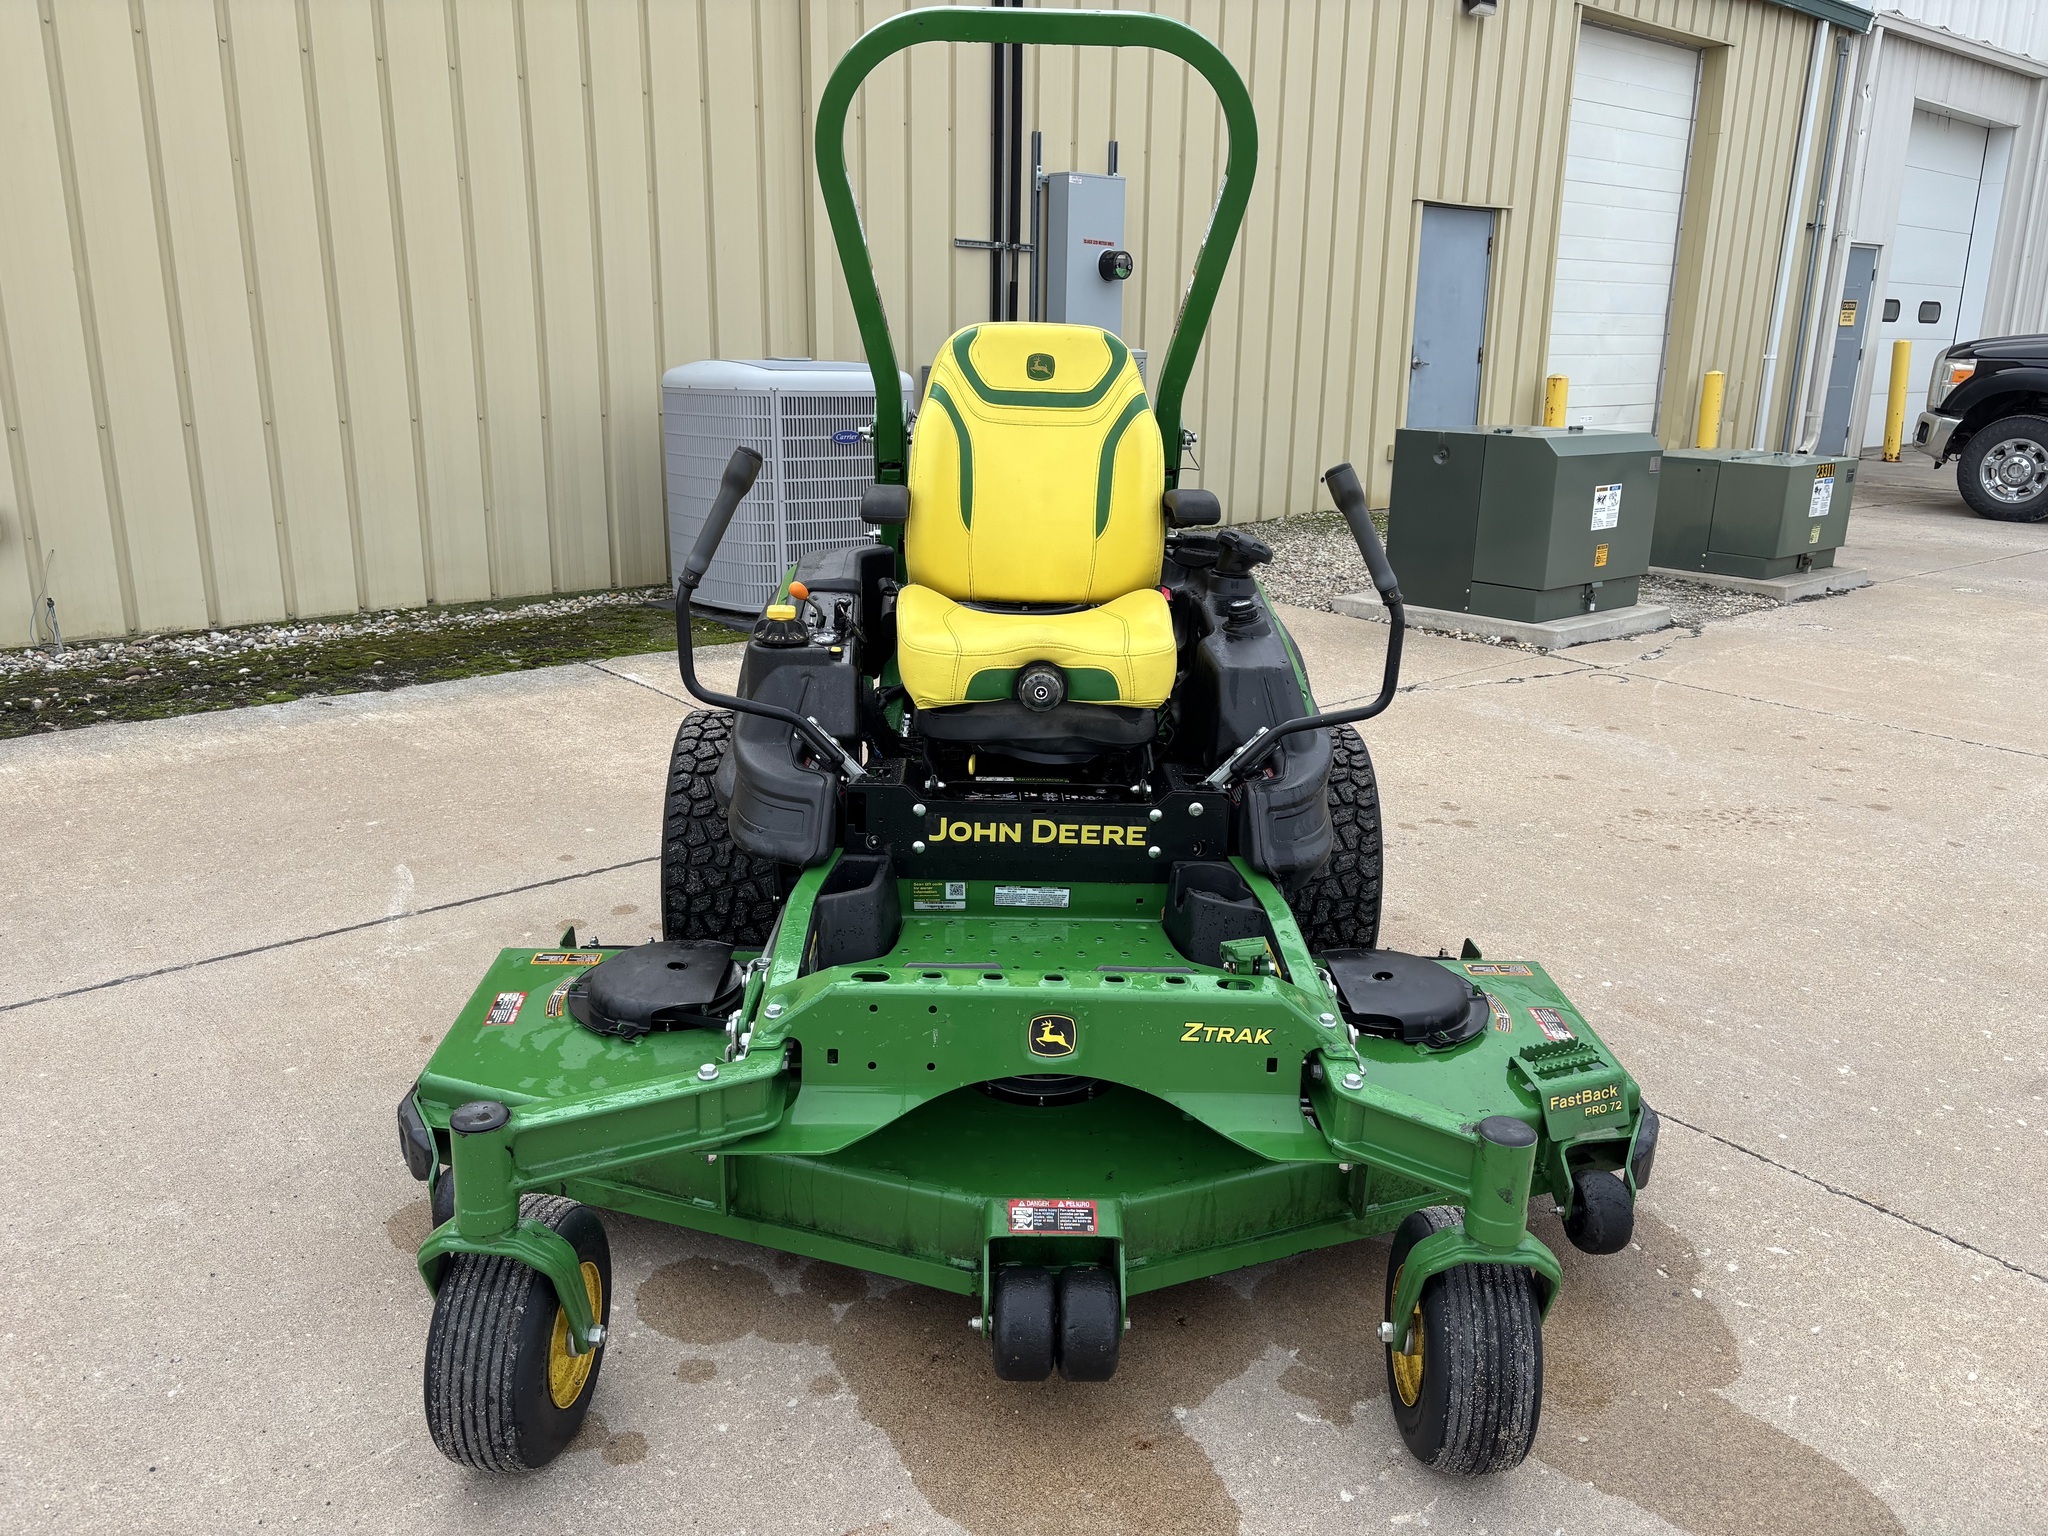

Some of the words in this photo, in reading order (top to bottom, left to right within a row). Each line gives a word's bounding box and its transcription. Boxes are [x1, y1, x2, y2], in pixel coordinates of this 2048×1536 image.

[1816, 463, 1835, 478] 23311
[928, 817, 1022, 843] JOHN
[1032, 819, 1147, 846] DEERE
[1180, 1021, 1276, 1045] ZTRAK
[1550, 1084, 1619, 1111] FastBack
[1584, 1103, 1608, 1117] PRO
[1609, 1100, 1622, 1112] 72
